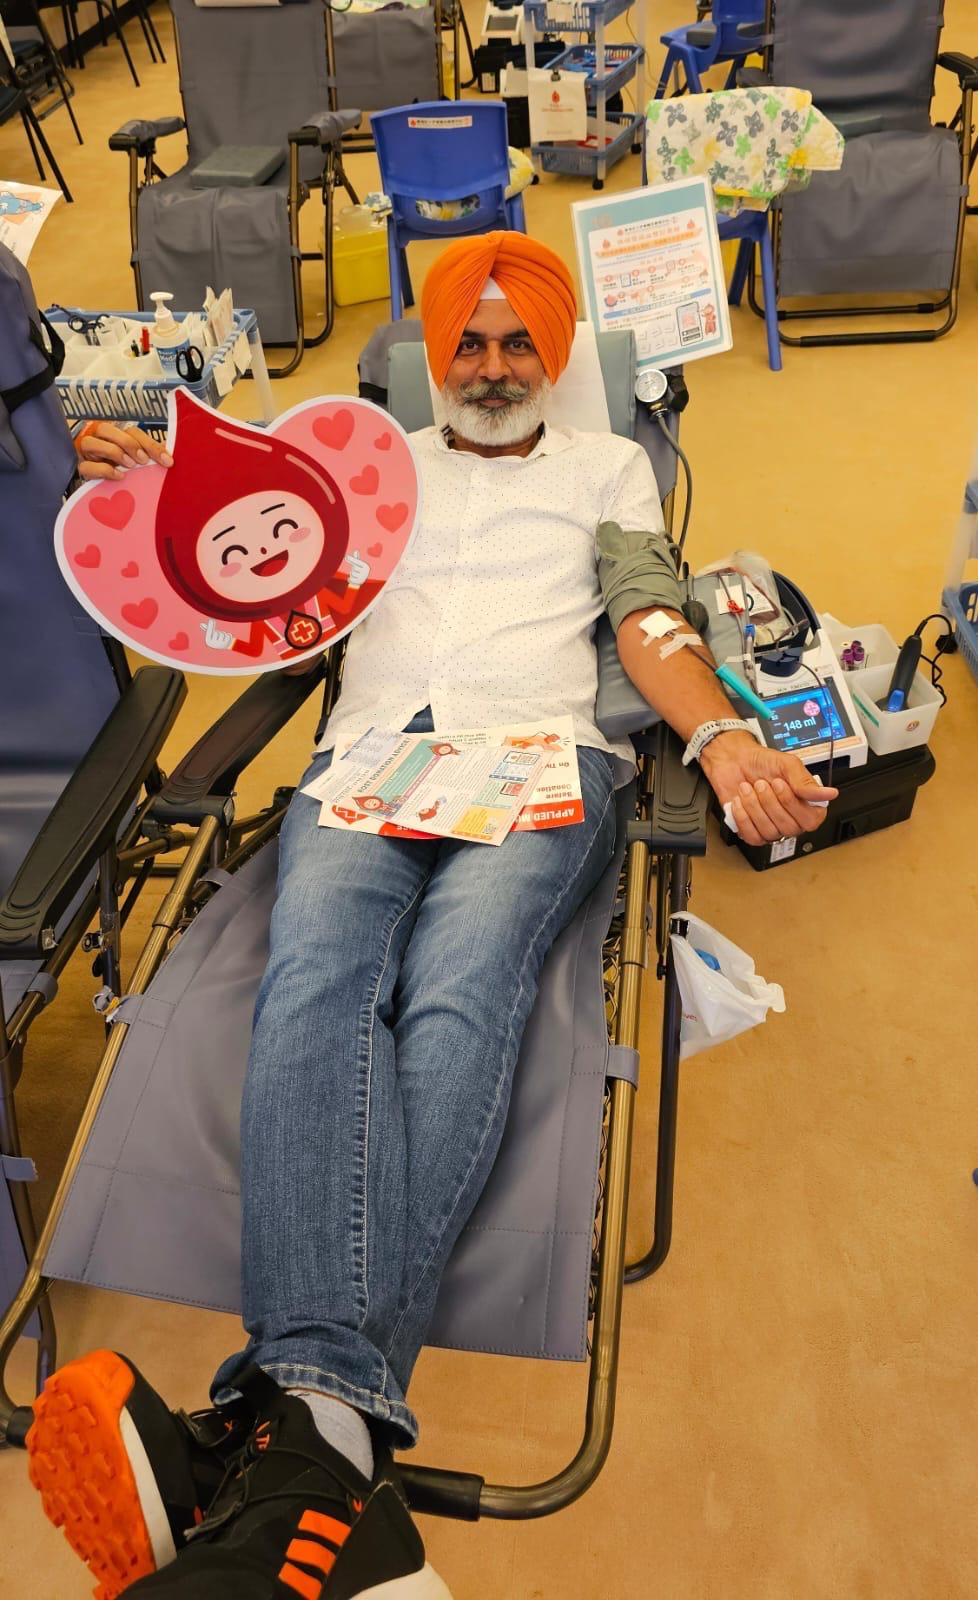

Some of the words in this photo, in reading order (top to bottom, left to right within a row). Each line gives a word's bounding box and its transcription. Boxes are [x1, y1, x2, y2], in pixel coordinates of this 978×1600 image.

[784, 720, 802, 731] 148
[804, 716, 817, 728] ml
[357, 781, 372, 793] POST
[369, 756, 394, 781] DONATION
[536, 783, 573, 793] Donation
[546, 791, 573, 799] Before
[533, 807, 575, 822] APPLIED
